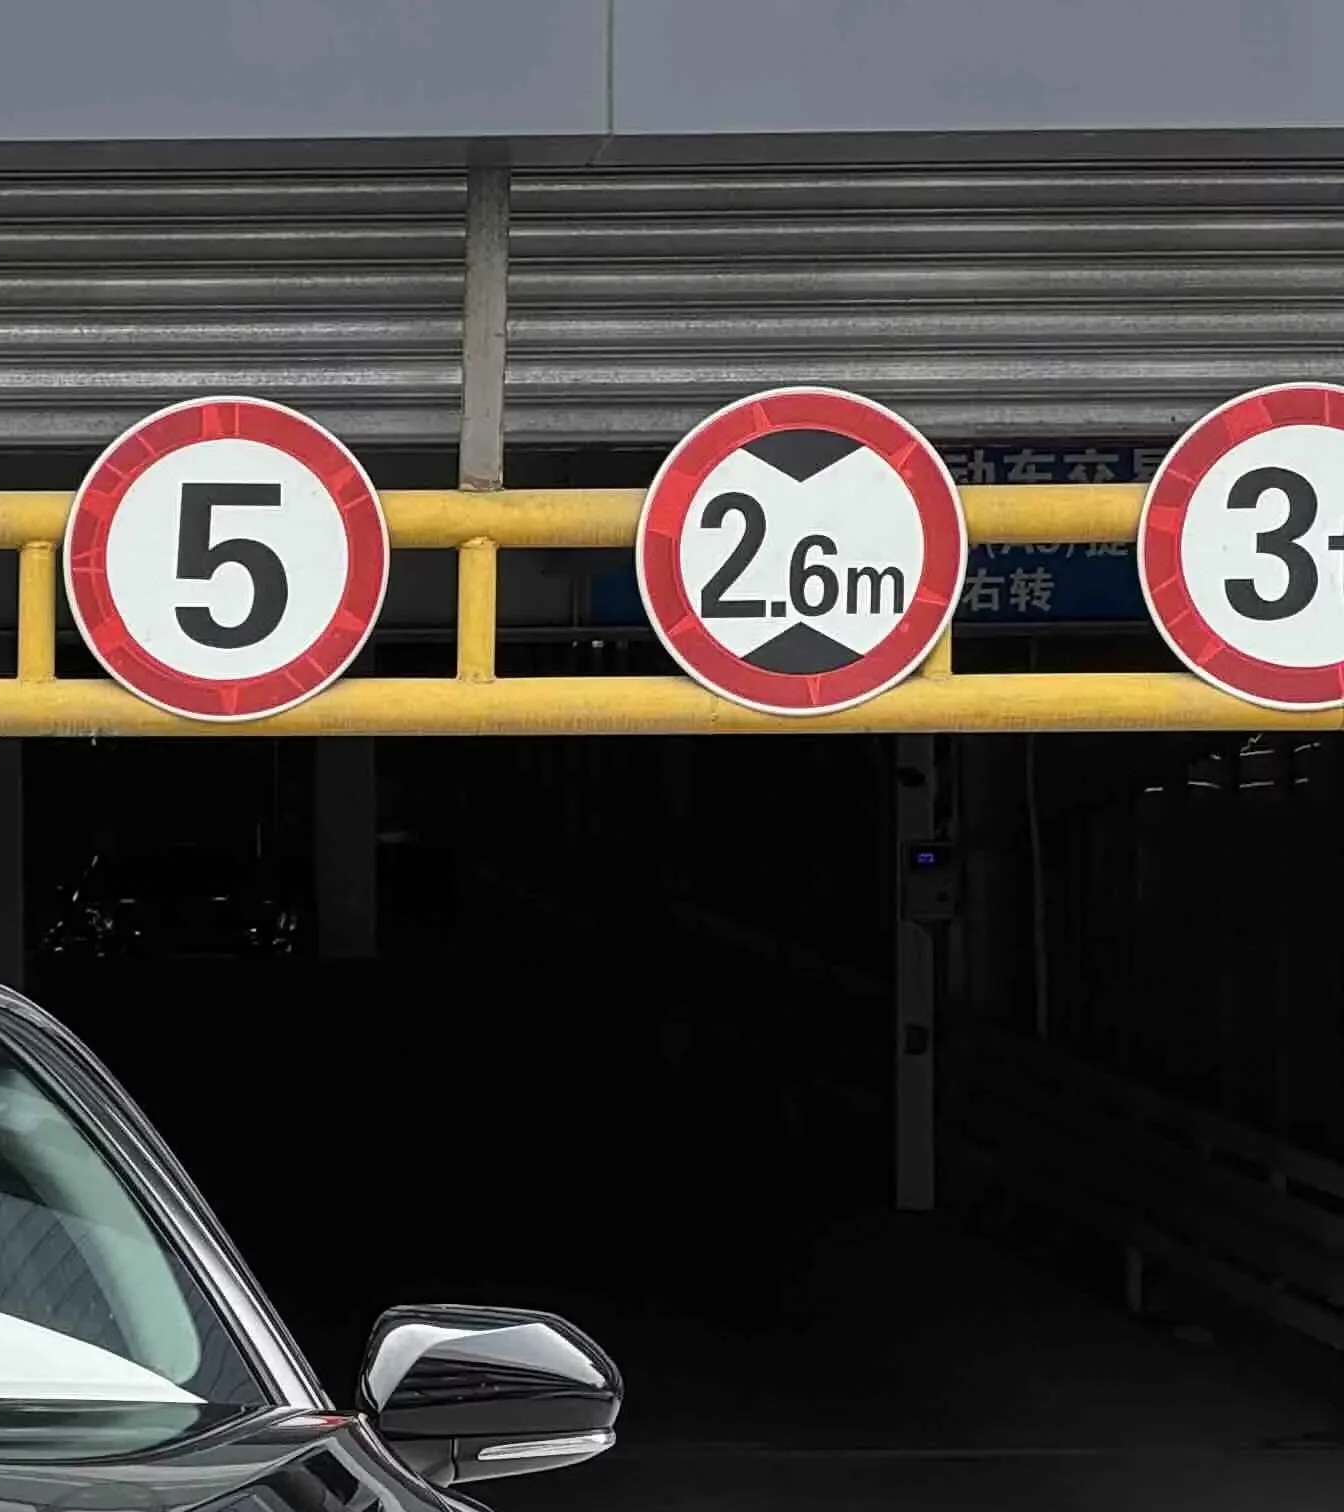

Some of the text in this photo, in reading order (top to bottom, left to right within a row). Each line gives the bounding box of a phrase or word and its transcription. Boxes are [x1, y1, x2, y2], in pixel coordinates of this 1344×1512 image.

[174, 482, 289, 650] 5
[700, 491, 905, 618] 2.6m
[963, 566, 1056, 613] 右转
[1224, 467, 1344, 621] 3
